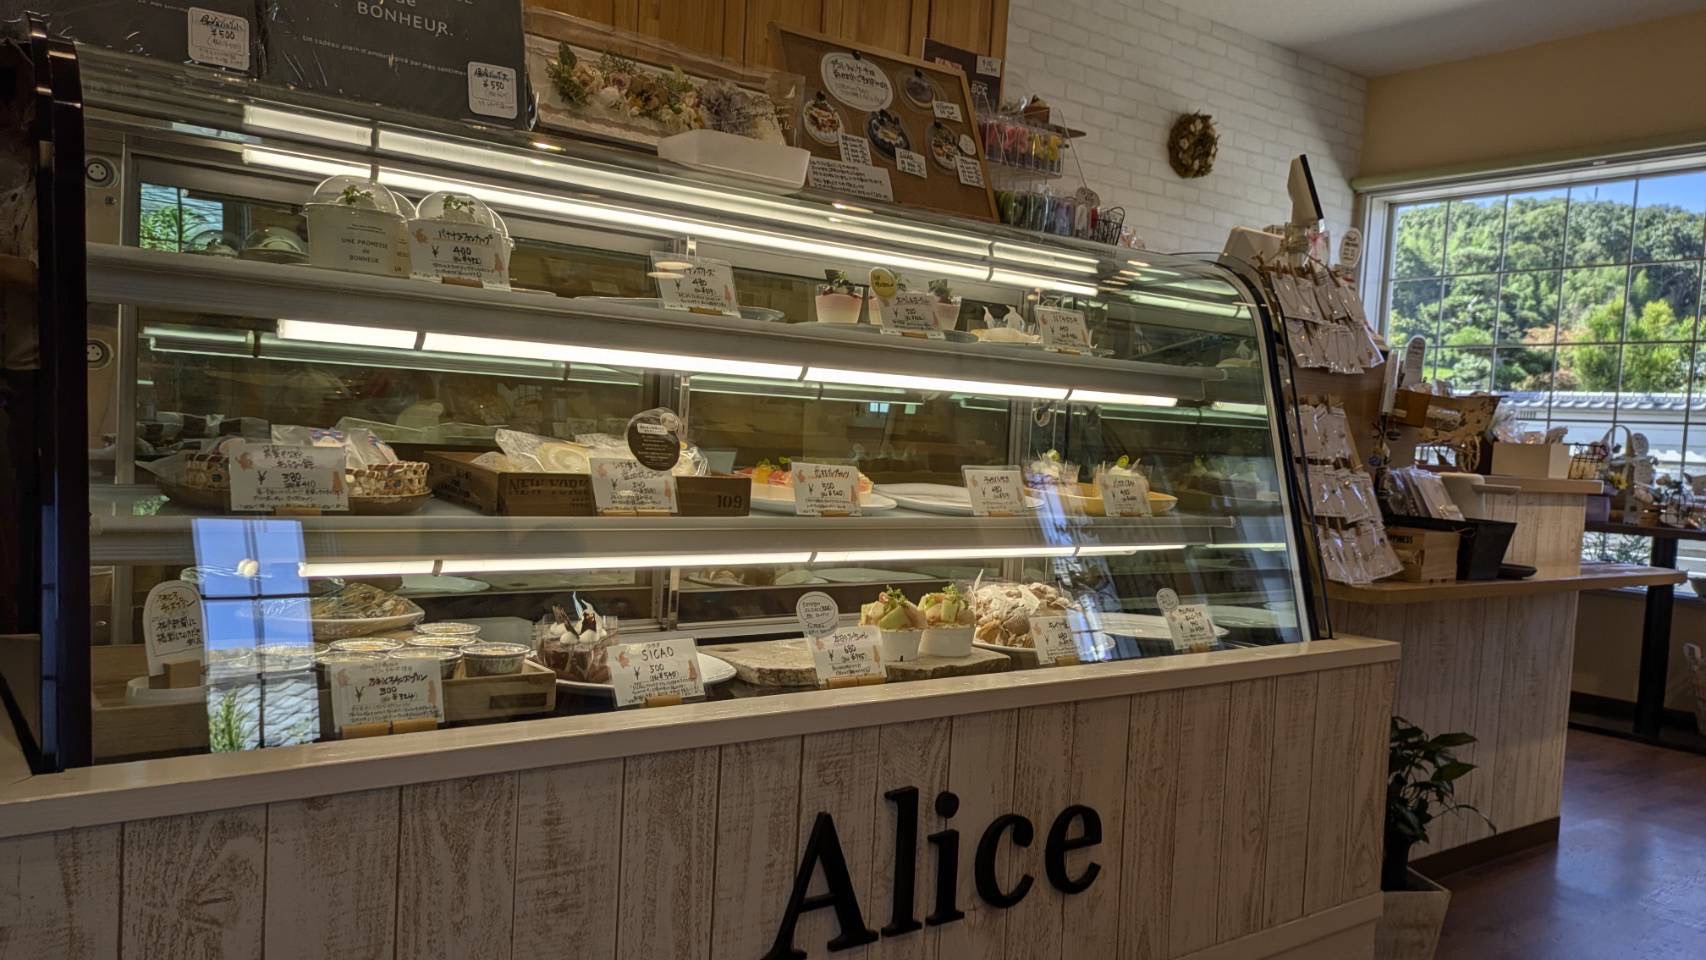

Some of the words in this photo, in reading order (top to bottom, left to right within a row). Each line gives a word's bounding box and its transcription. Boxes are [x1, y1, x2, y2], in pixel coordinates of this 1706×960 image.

[357, 1, 454, 36] BONHEUR.
[717, 495, 743, 508] 109
[641, 646, 674, 661] SICAO
[760, 786, 1102, 960] Alice
